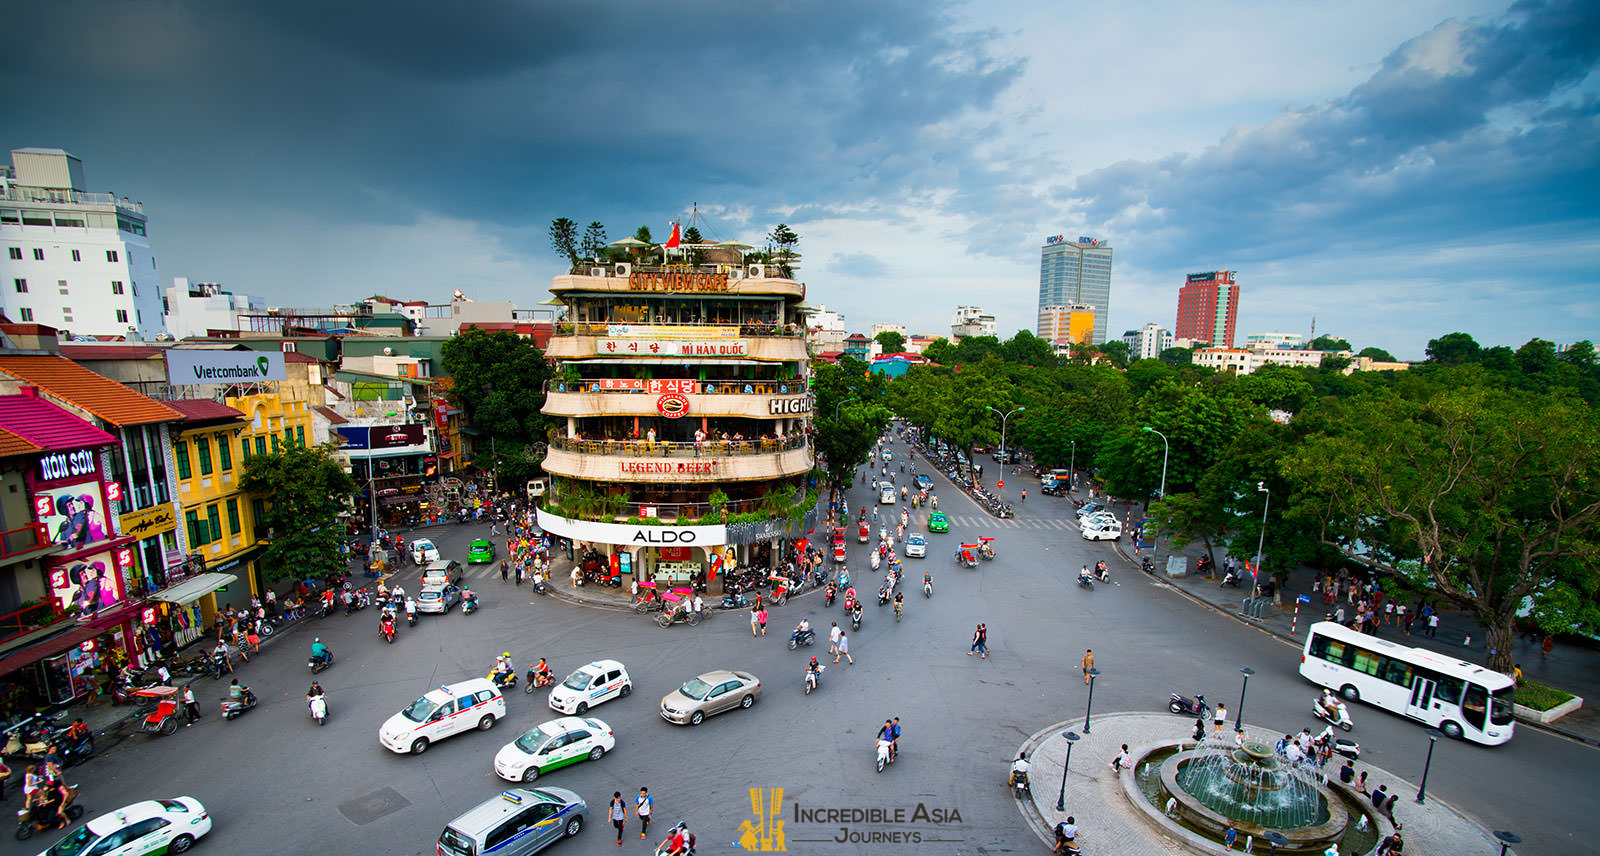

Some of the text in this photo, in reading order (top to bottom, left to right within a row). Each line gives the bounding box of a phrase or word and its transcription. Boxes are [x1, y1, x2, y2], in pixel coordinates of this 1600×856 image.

[629, 272, 728, 291] CITY VIEW CAFE
[193, 365, 259, 379] Vietcombank
[650, 380, 694, 393] 한식당
[40, 449, 95, 480] NÓN SƠN
[621, 462, 672, 473] LEGEND
[633, 530, 696, 543] ALDO
